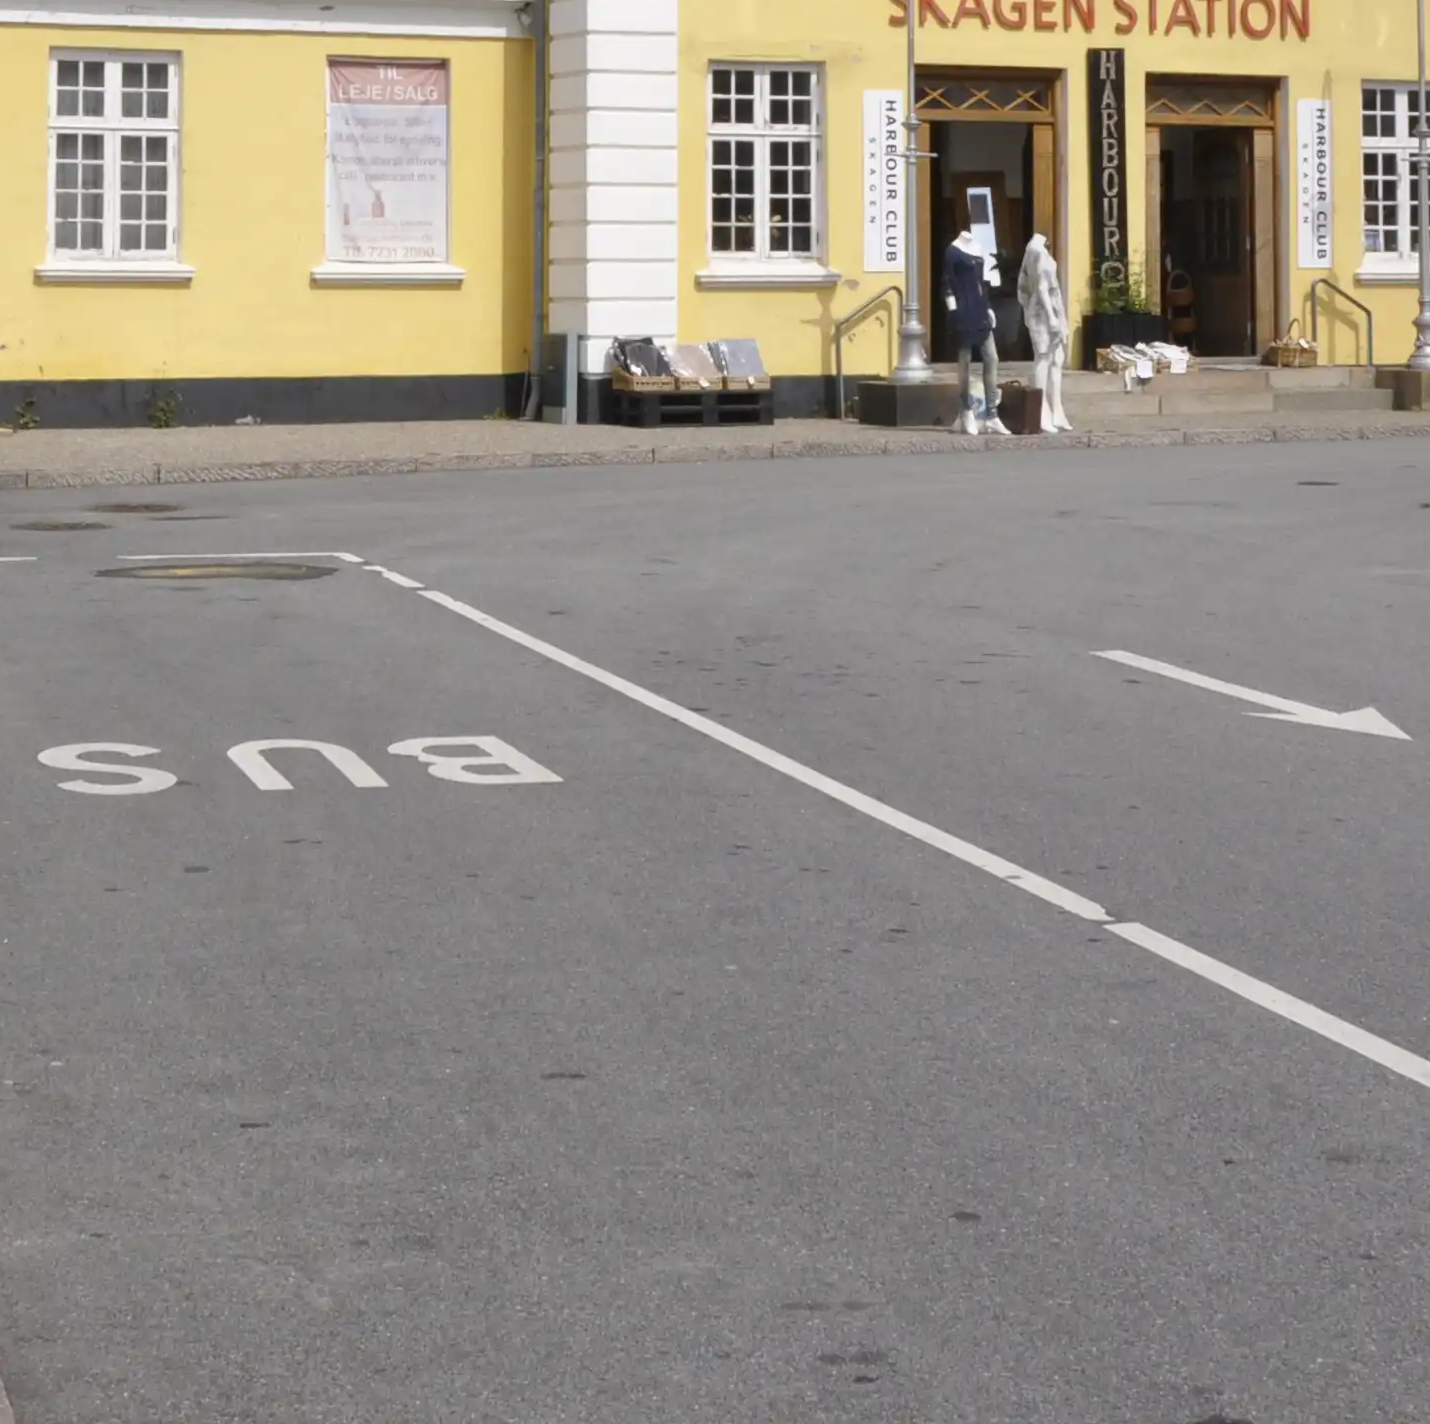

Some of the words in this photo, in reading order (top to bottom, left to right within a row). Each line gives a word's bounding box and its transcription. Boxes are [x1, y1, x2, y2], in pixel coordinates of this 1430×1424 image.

[376, 65, 404, 80] TIL
[868, 137, 877, 224] SKAGEN
[885, 100, 898, 200] HARBOUR
[1099, 50, 1120, 256] HARBOUR
[1315, 108, 1328, 202] HARBOUR
[885, 210, 898, 263] CLUB
[1316, 210, 1328, 259] CLUB
[37, 735, 564, 796] BUS
